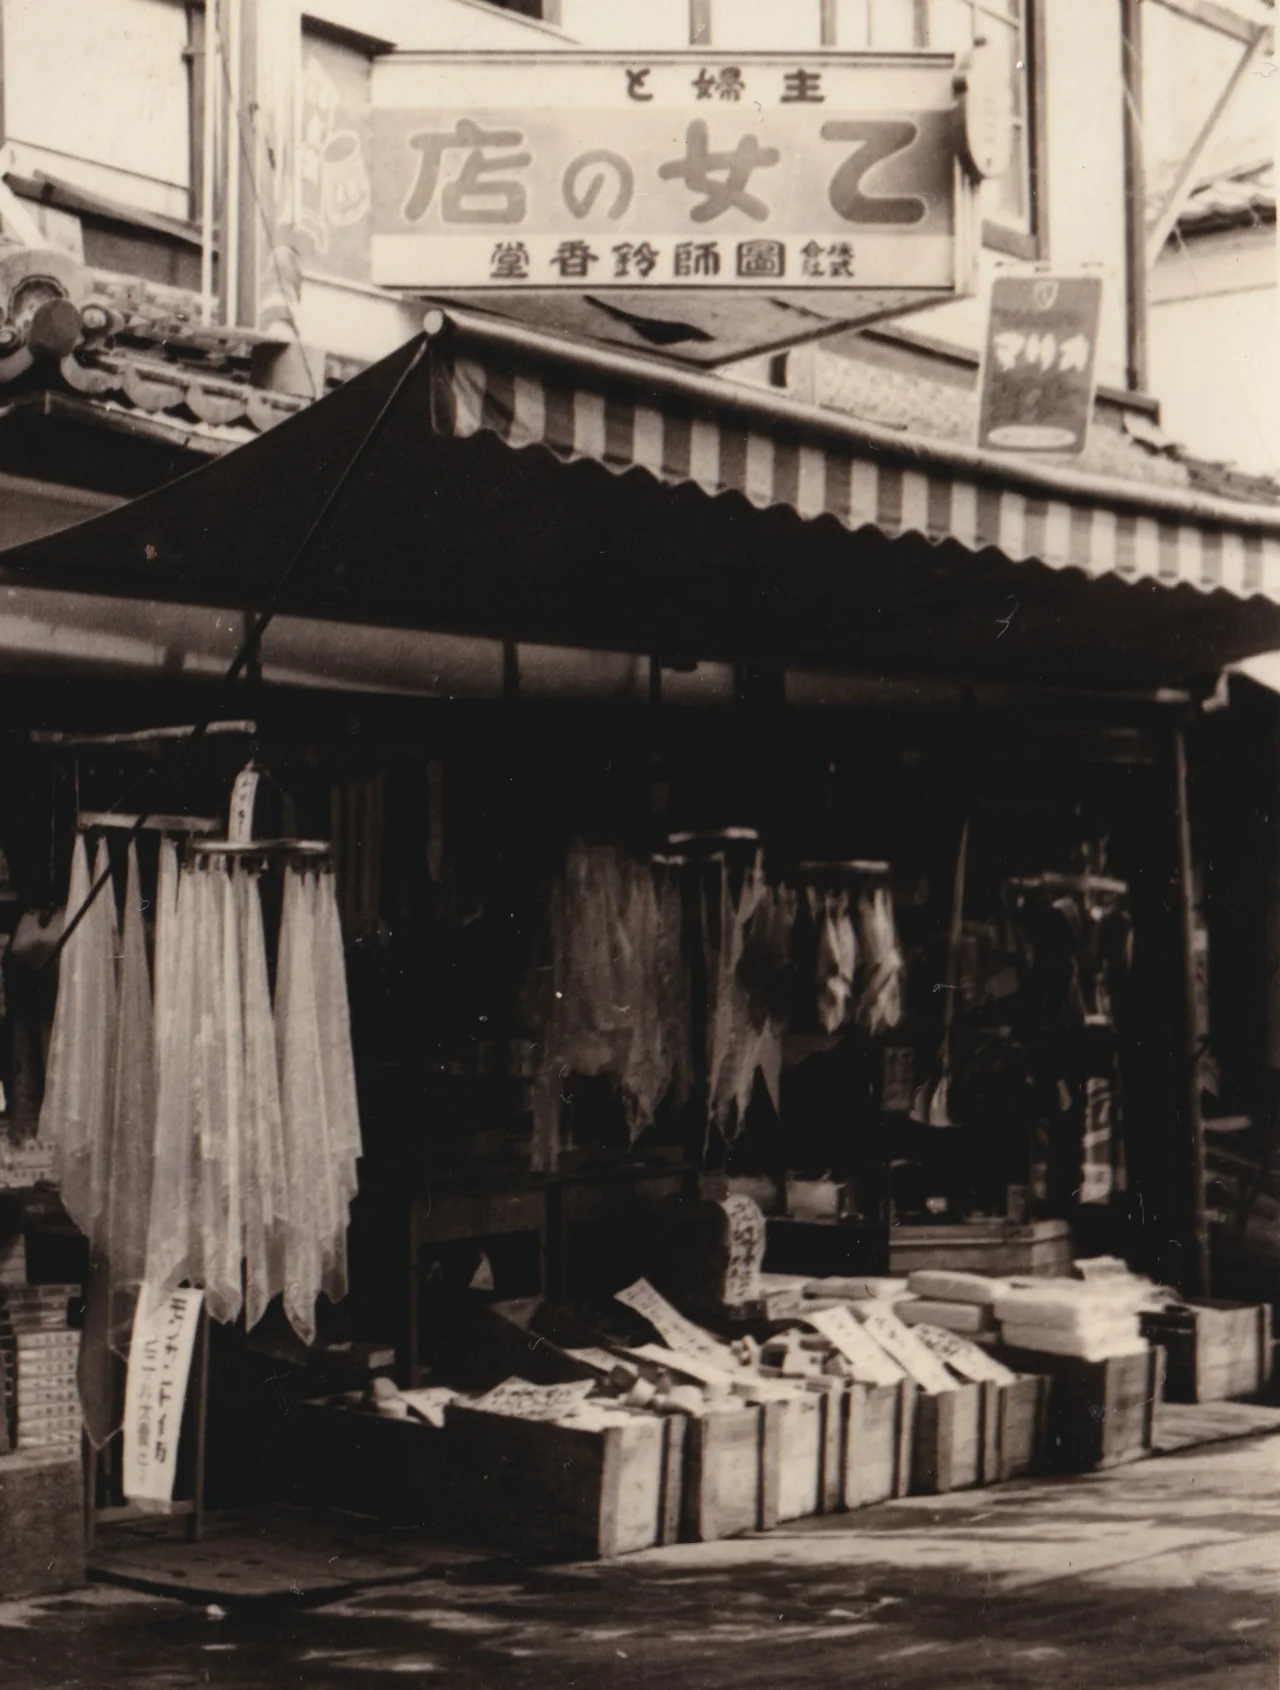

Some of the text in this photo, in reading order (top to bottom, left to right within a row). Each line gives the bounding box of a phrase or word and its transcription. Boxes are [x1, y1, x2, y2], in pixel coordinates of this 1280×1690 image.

[623, 67, 827, 104] 主婦と
[402, 118, 926, 226] 乙女の店
